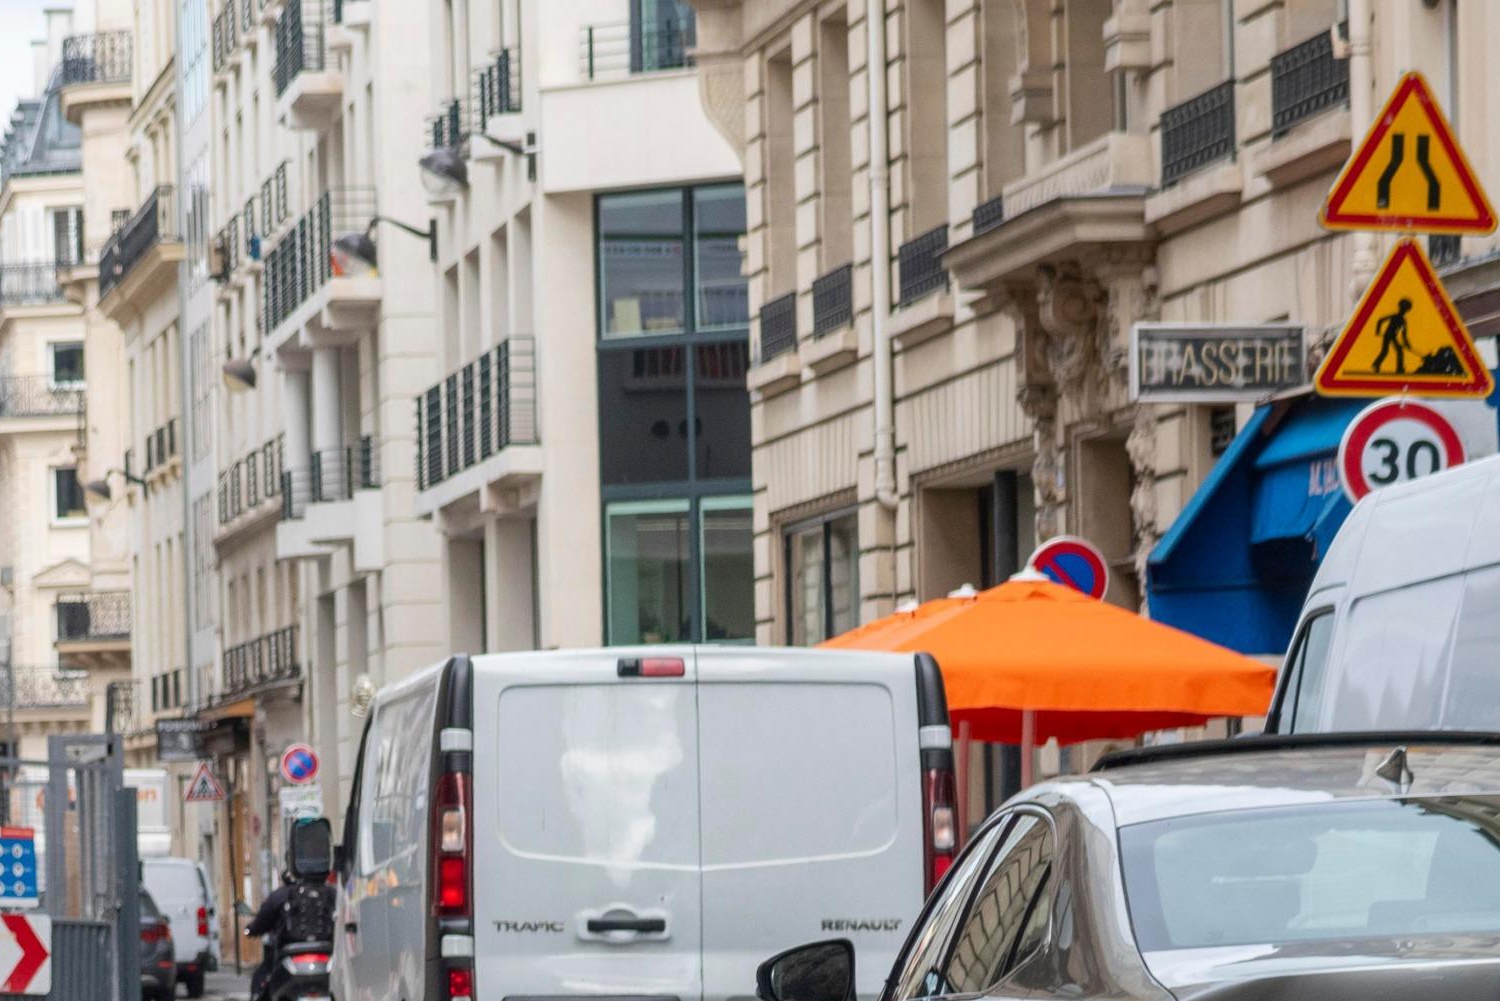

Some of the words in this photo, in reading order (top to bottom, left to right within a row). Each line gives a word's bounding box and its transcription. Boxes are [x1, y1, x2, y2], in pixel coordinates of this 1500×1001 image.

[1140, 339, 1297, 386] BRASSERIE
[1368, 438, 1441, 485] 30
[493, 920, 564, 933] TRAFIC
[821, 919, 902, 931] RENAULT
